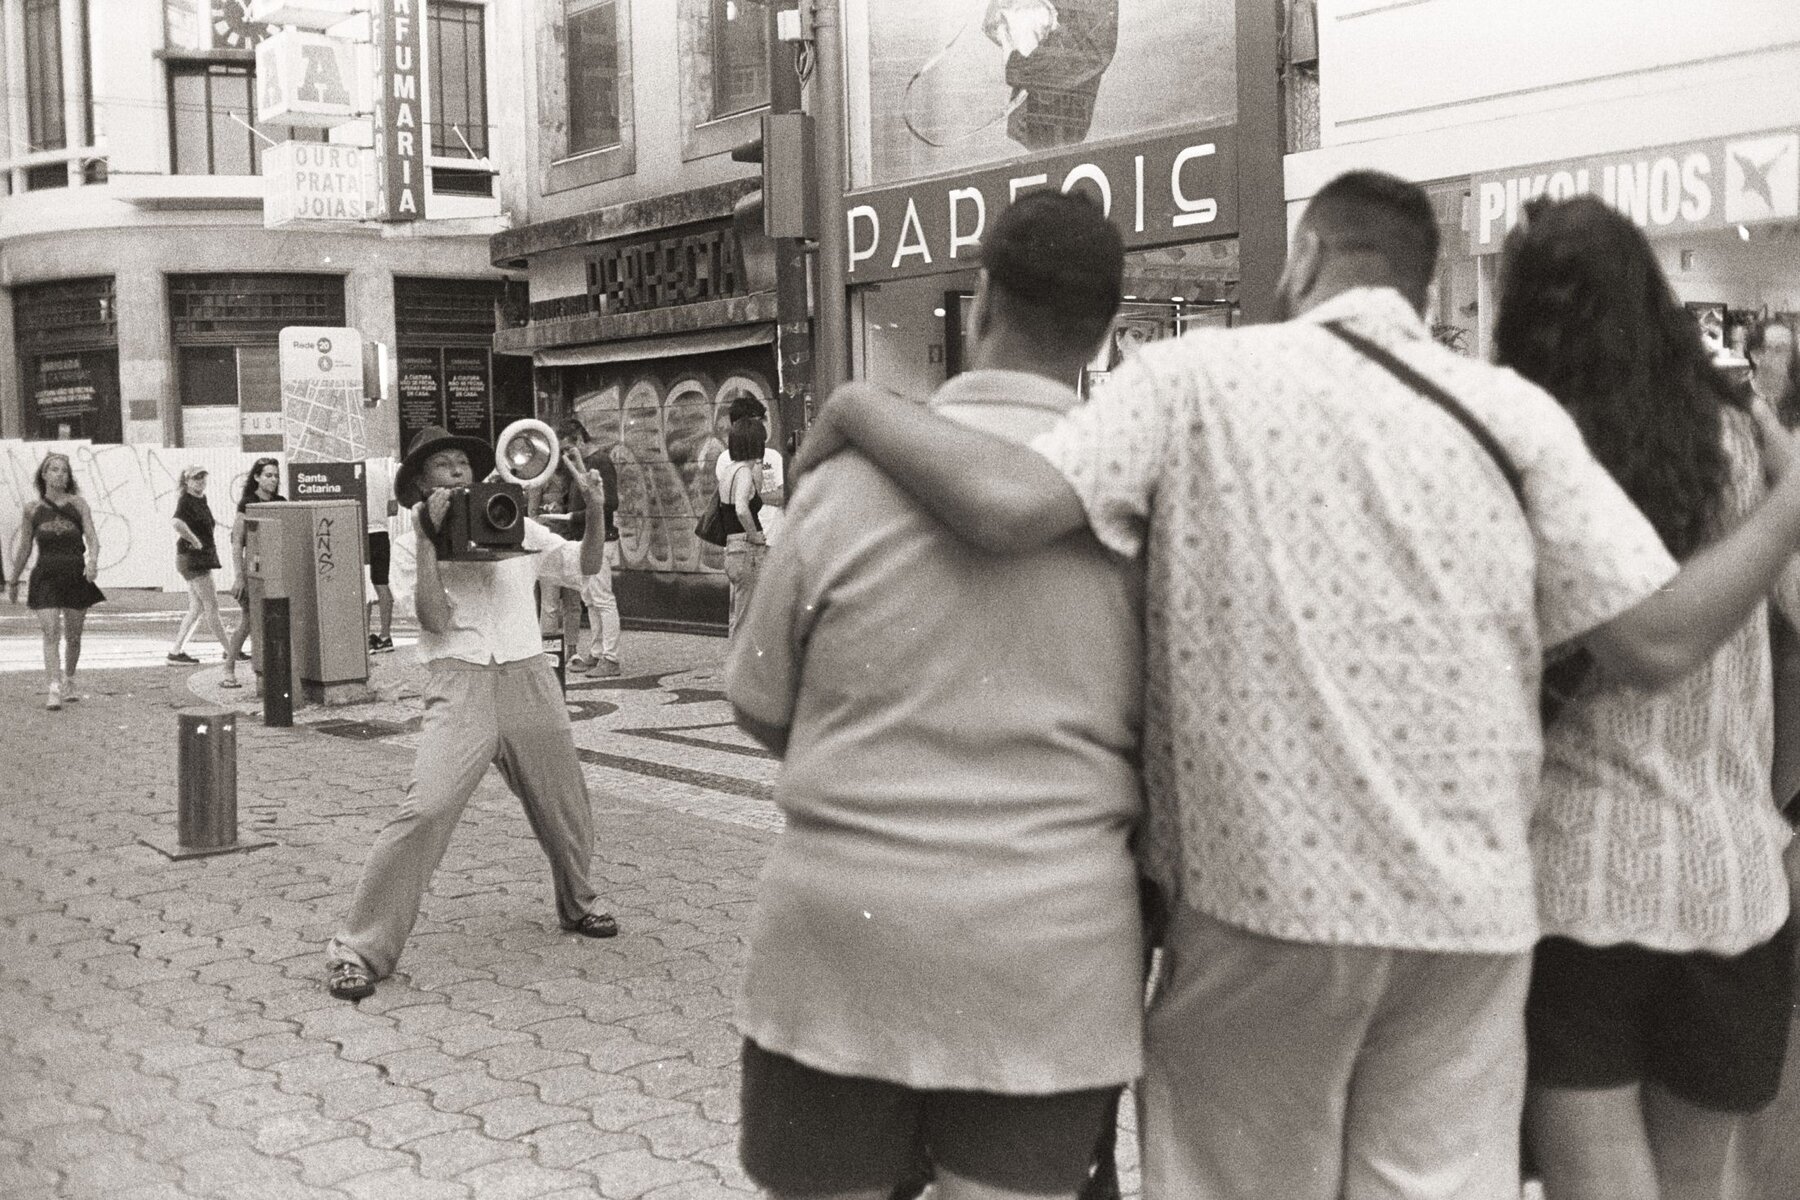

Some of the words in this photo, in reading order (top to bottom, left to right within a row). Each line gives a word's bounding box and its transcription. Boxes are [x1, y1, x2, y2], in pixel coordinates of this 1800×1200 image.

[297, 45, 350, 106] A
[295, 146, 358, 168] OURO
[295, 171, 359, 193] PRATA
[298, 196, 361, 218] JOIAS
[293, 341, 315, 349] Rede
[297, 473, 328, 483] Santa
[298, 484, 341, 494] Catarina
